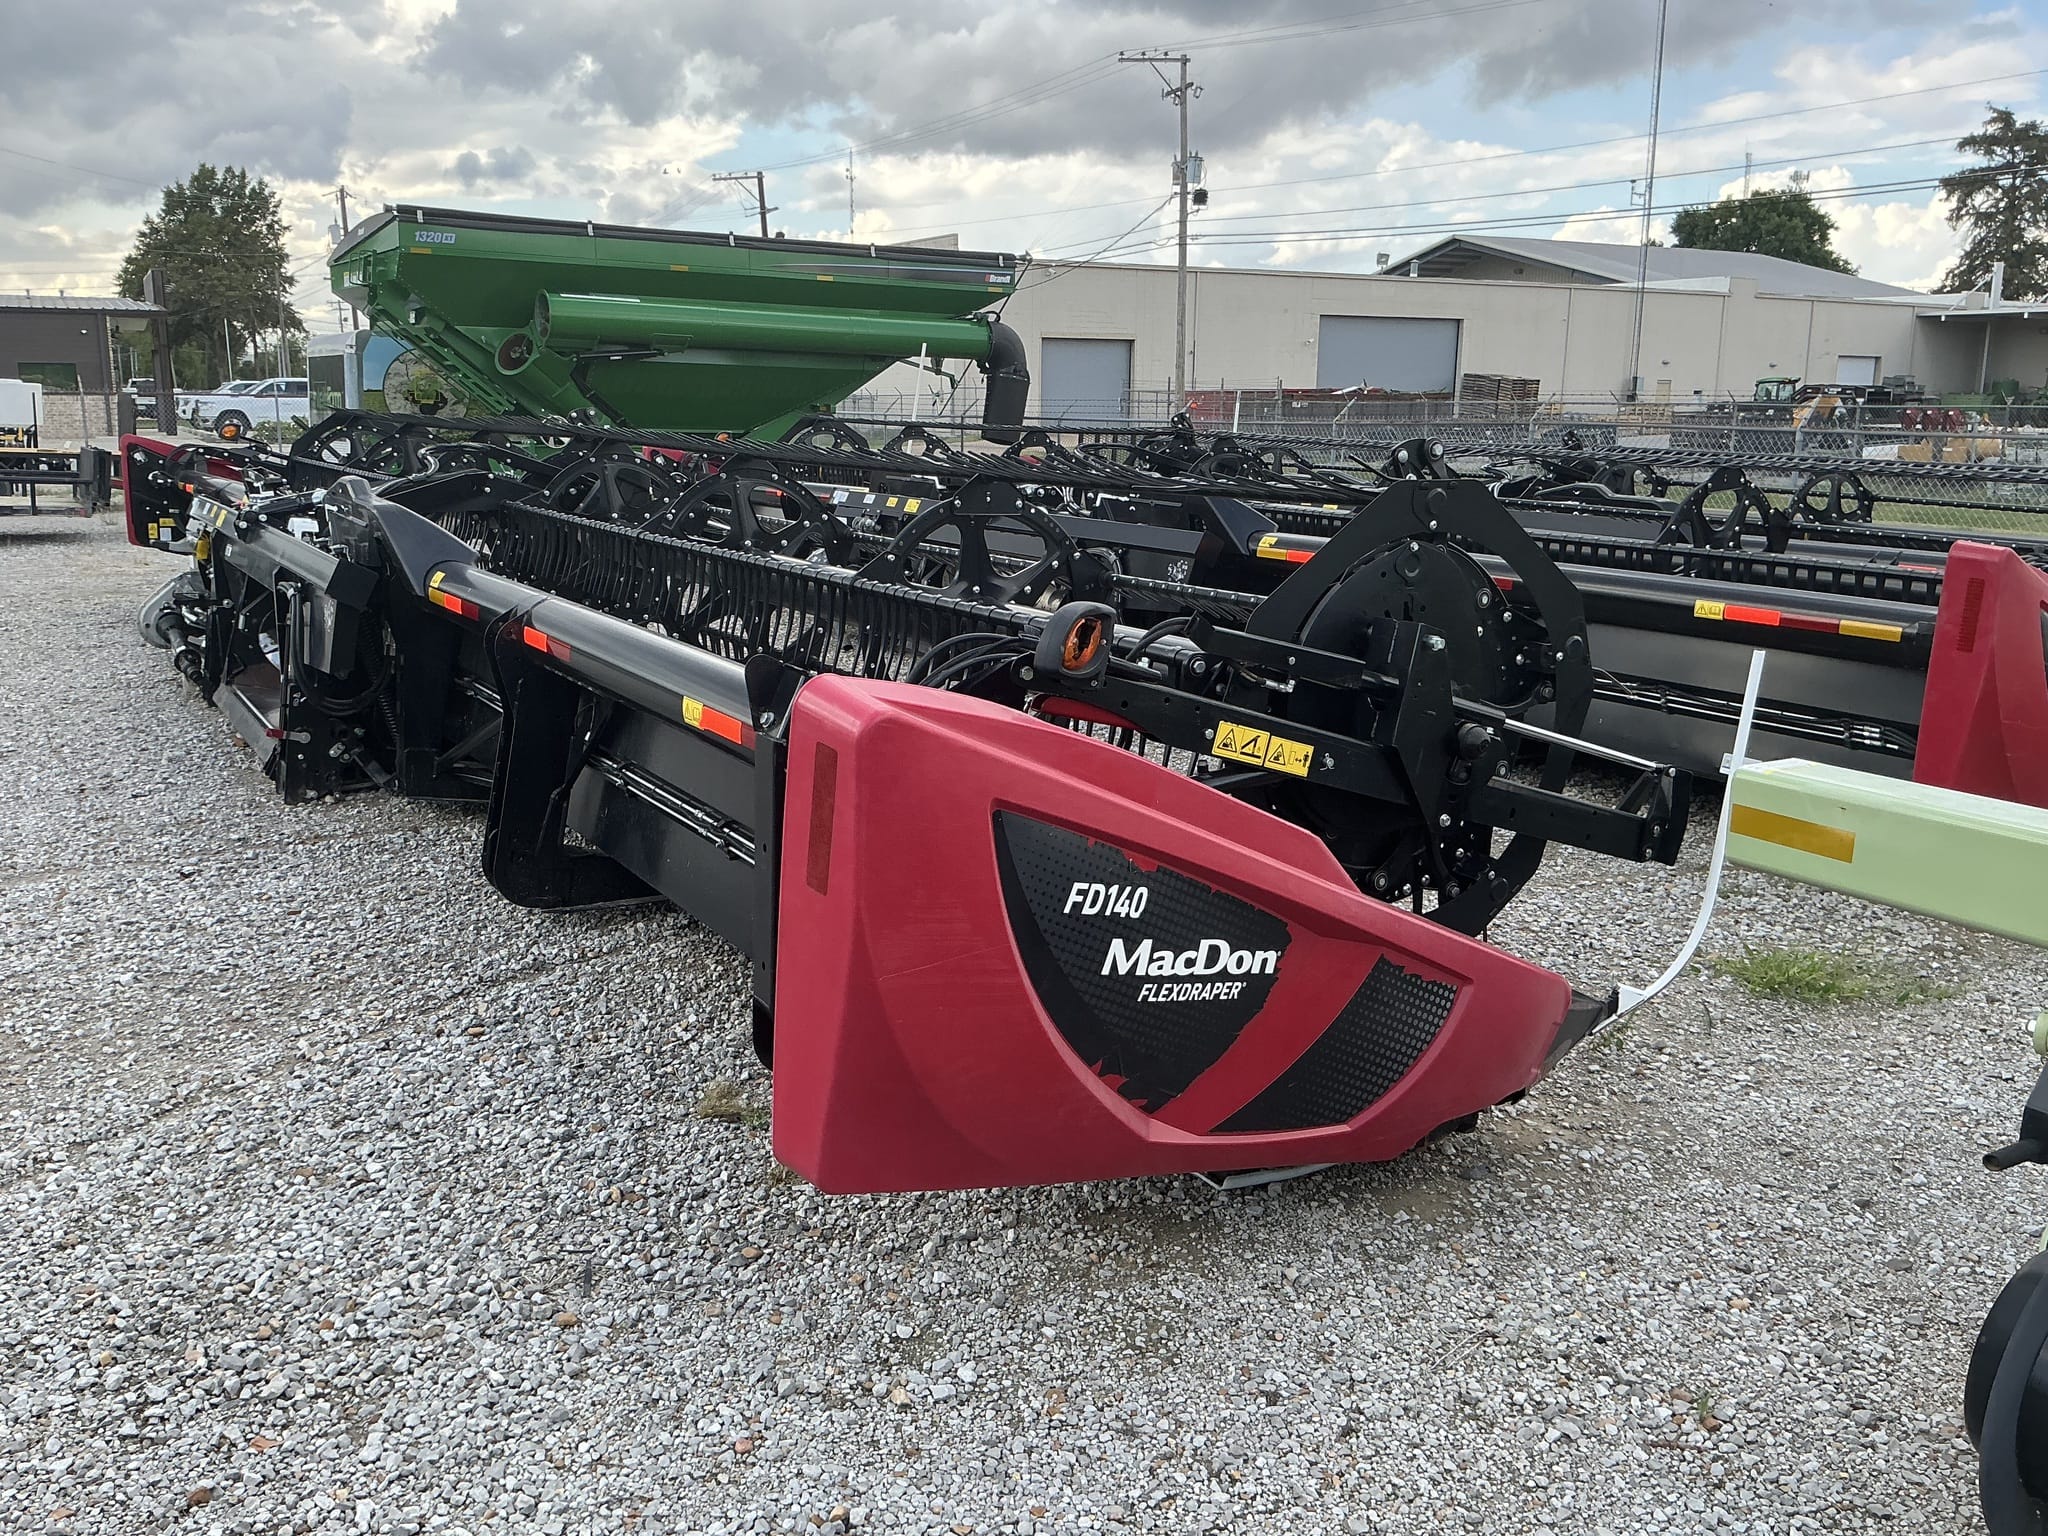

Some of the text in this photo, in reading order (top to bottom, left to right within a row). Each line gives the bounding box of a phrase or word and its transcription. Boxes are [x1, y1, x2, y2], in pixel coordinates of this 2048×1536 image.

[1063, 882, 1149, 919] FD140
[1100, 938, 1278, 977] MacDon
[1137, 982, 1244, 1002] FLEXDRAPER
